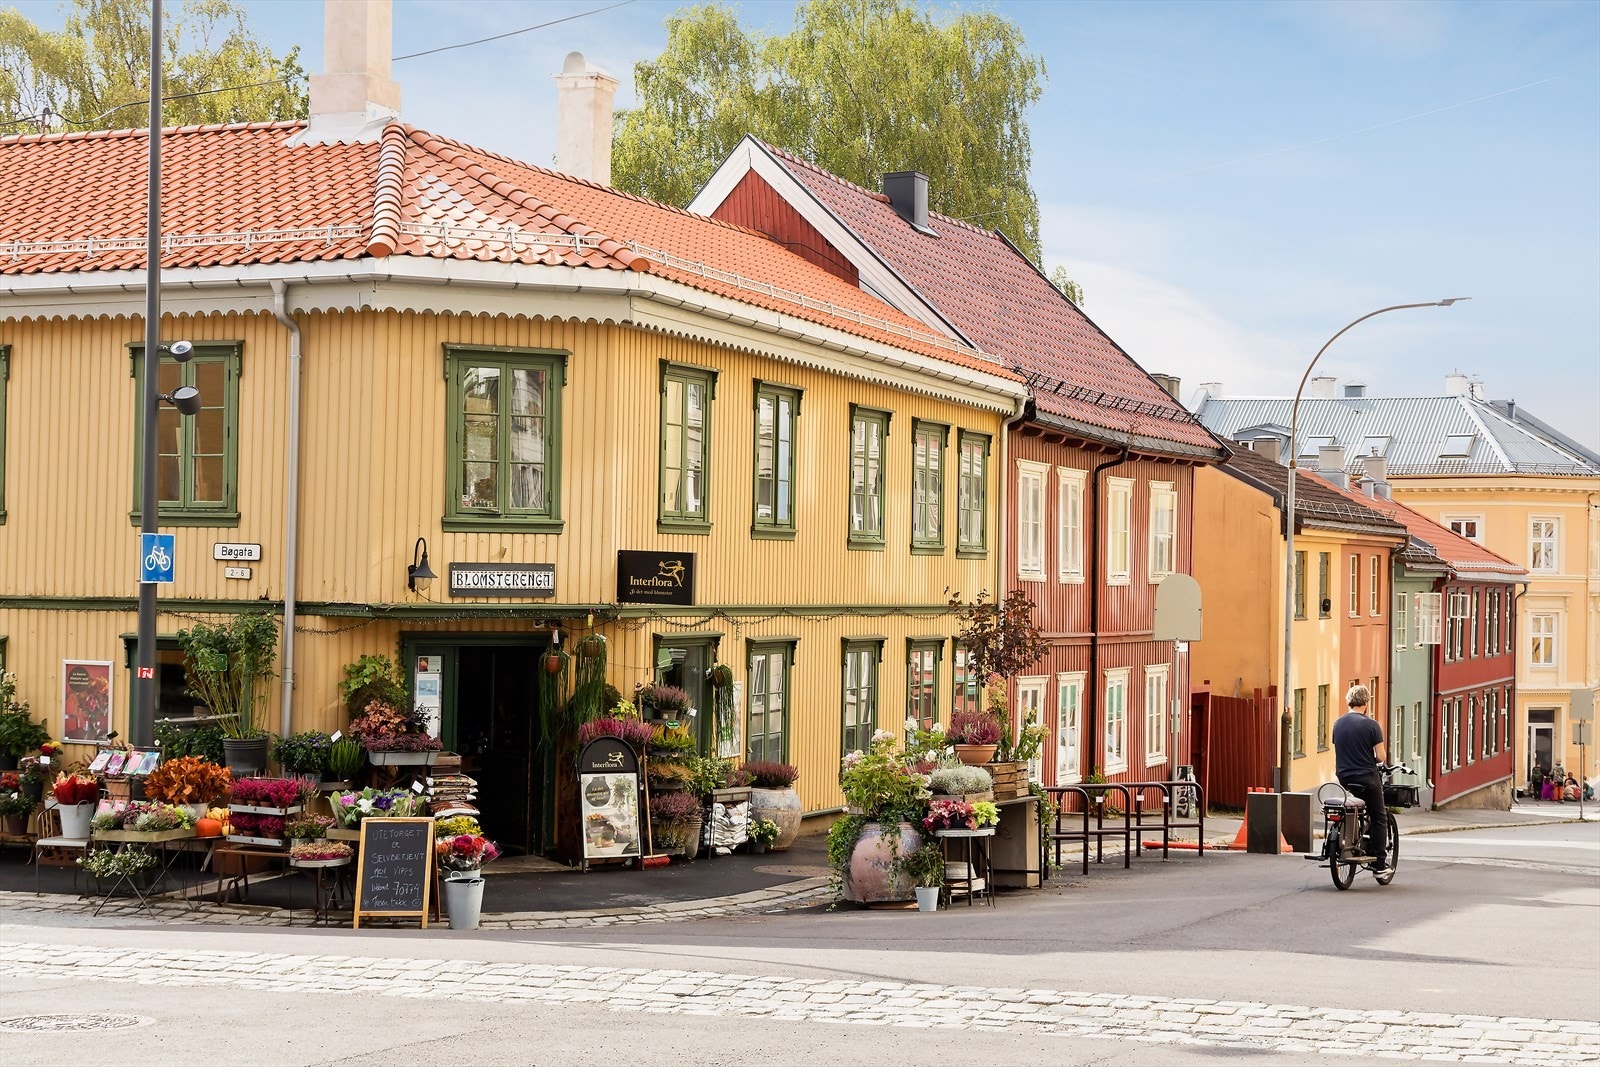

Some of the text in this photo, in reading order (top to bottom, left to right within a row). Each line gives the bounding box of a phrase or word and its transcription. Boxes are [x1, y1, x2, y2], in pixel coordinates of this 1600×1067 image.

[221, 546, 253, 559] Bøgata
[456, 573, 550, 587] BLOMSTERENGA
[629, 575, 673, 587] Interflora
